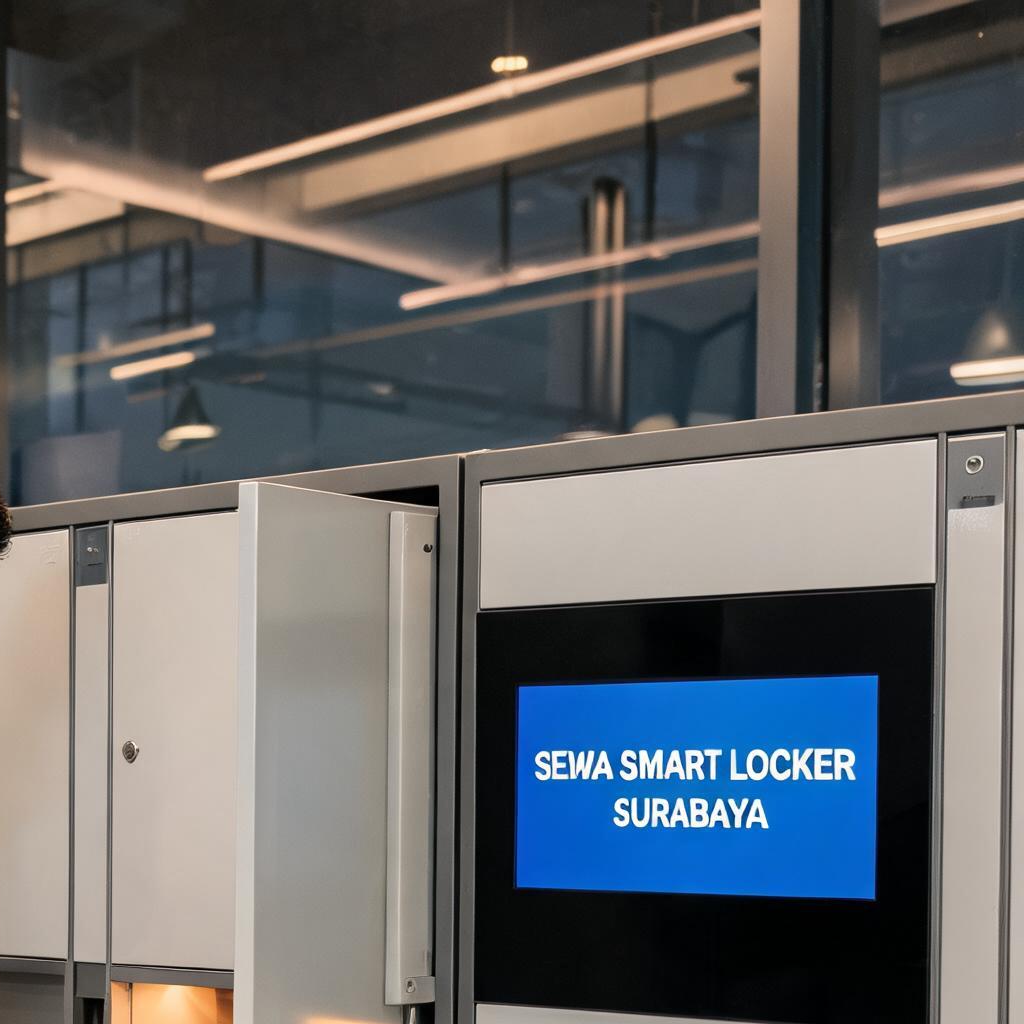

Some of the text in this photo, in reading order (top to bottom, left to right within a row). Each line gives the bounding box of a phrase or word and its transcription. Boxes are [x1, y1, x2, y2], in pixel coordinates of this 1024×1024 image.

[534, 748, 857, 781] SEWA SMART LOCKER
[613, 797, 769, 829] SURABAYA
